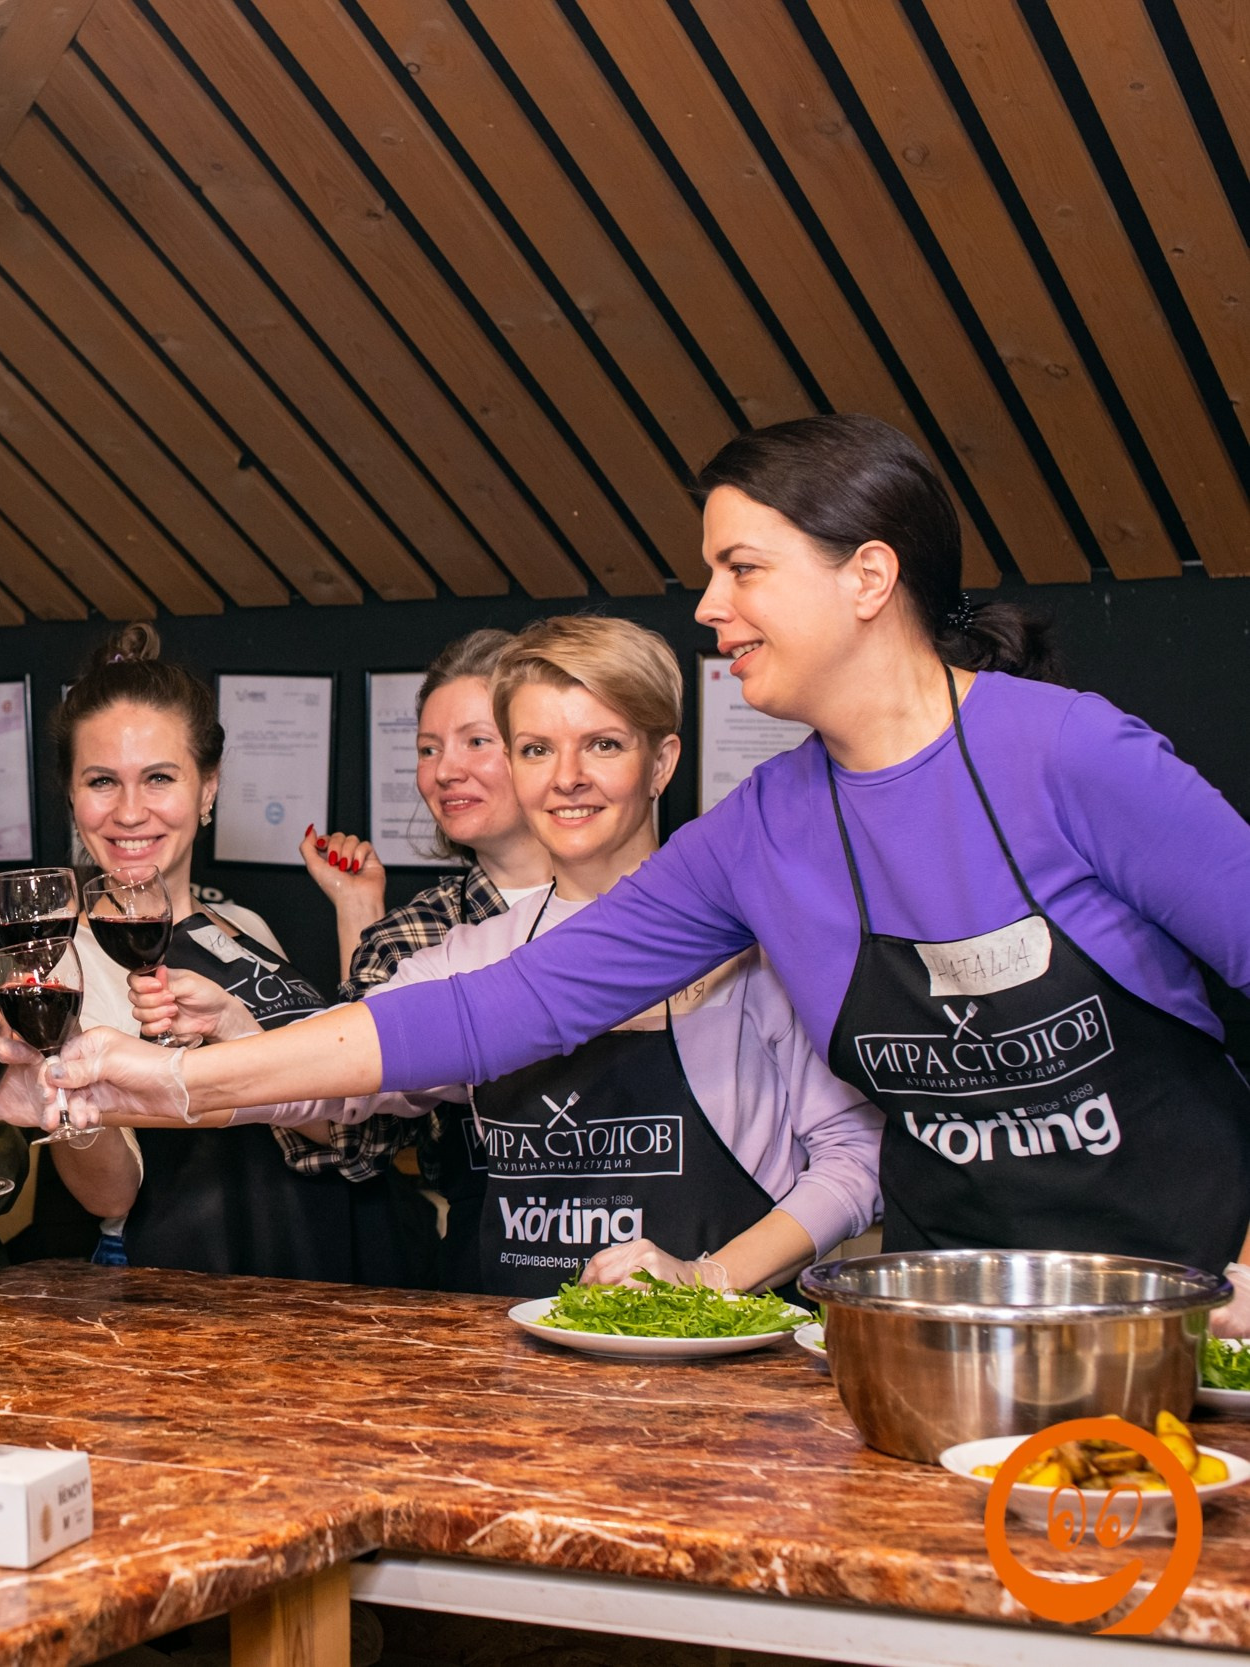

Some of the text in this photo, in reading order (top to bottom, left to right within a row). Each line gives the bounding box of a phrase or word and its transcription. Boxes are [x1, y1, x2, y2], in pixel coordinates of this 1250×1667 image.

[864, 1009, 1099, 1074] ИГРА СТОЛОВ
[905, 1059, 1067, 1088] КУЛИНАРНАЯ СТУДИЯ
[1026, 1083, 1094, 1115] since 1889
[483, 1128, 540, 1159] ИГРА
[544, 1124, 672, 1157] СТОЛОВ
[903, 1092, 1121, 1164] körting
[497, 1158, 631, 1172] КУЛИНАРНАЯ СТУДИЯ
[581, 1195, 633, 1206] since 1889
[499, 1197, 642, 1247] körting
[500, 1252, 579, 1269] встраиваемая
